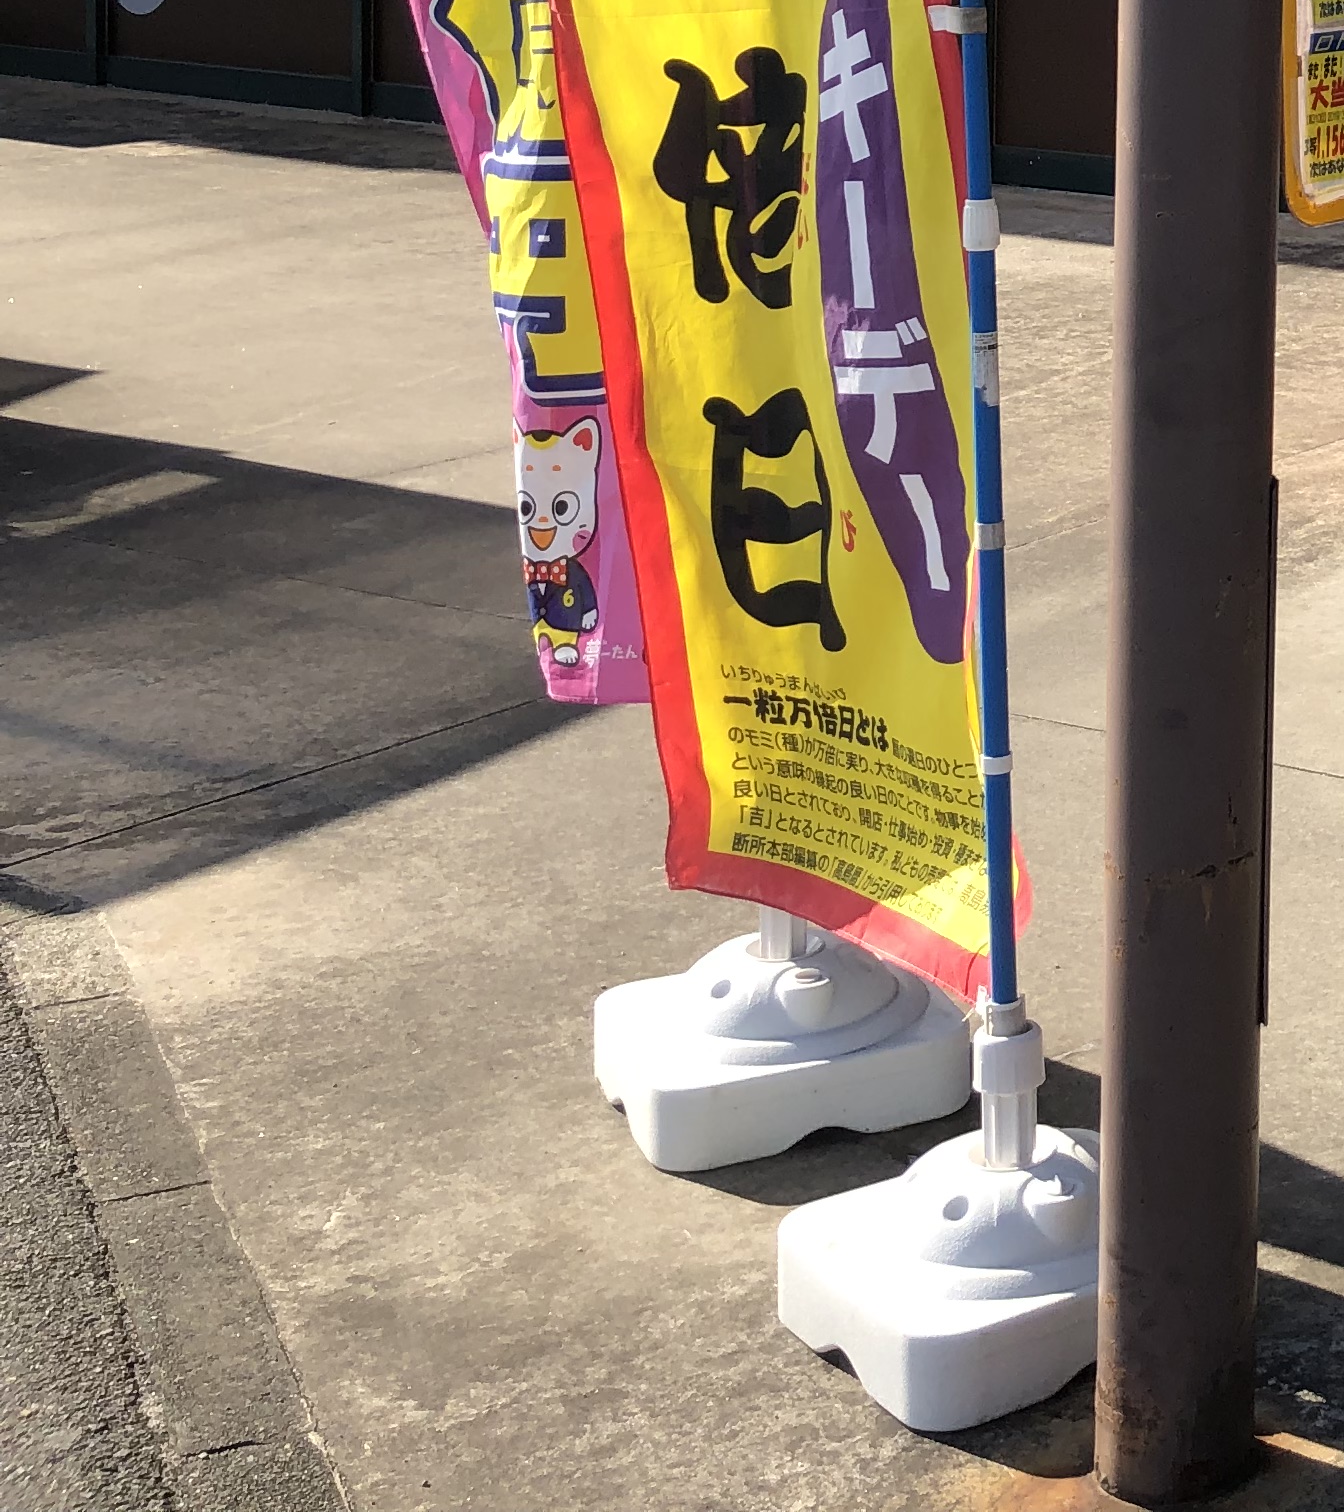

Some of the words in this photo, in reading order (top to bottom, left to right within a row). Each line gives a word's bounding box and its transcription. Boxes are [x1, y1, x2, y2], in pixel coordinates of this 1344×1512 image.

[723, 687, 889, 752] 一粒万倍日とは
